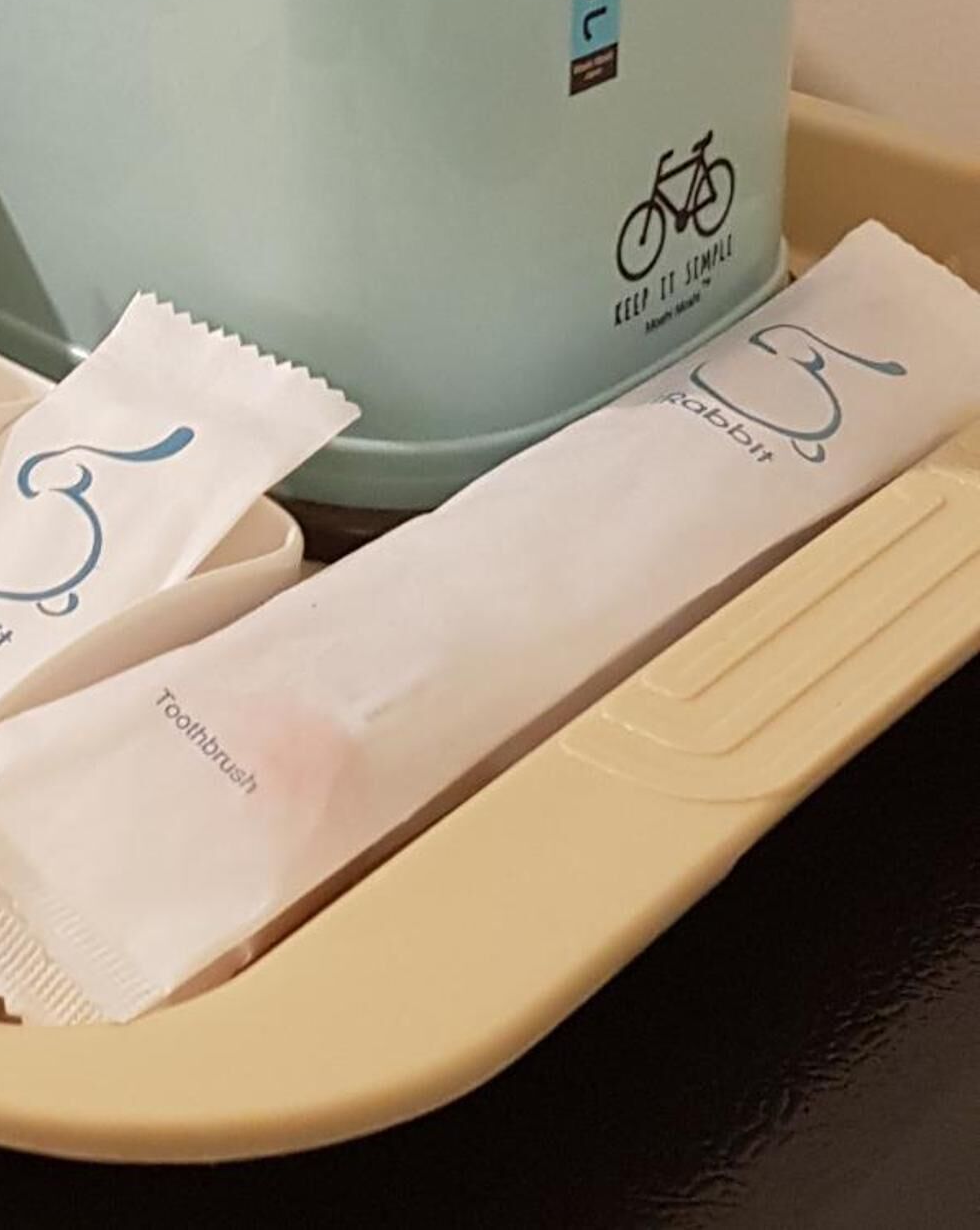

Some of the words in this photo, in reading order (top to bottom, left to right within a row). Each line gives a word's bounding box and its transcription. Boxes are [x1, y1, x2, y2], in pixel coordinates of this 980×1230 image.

[614, 286, 649, 327] KEEP
[660, 270, 675, 301] IT
[685, 233, 732, 287] SIMPLE
[155, 687, 258, 795] Toothbrush
